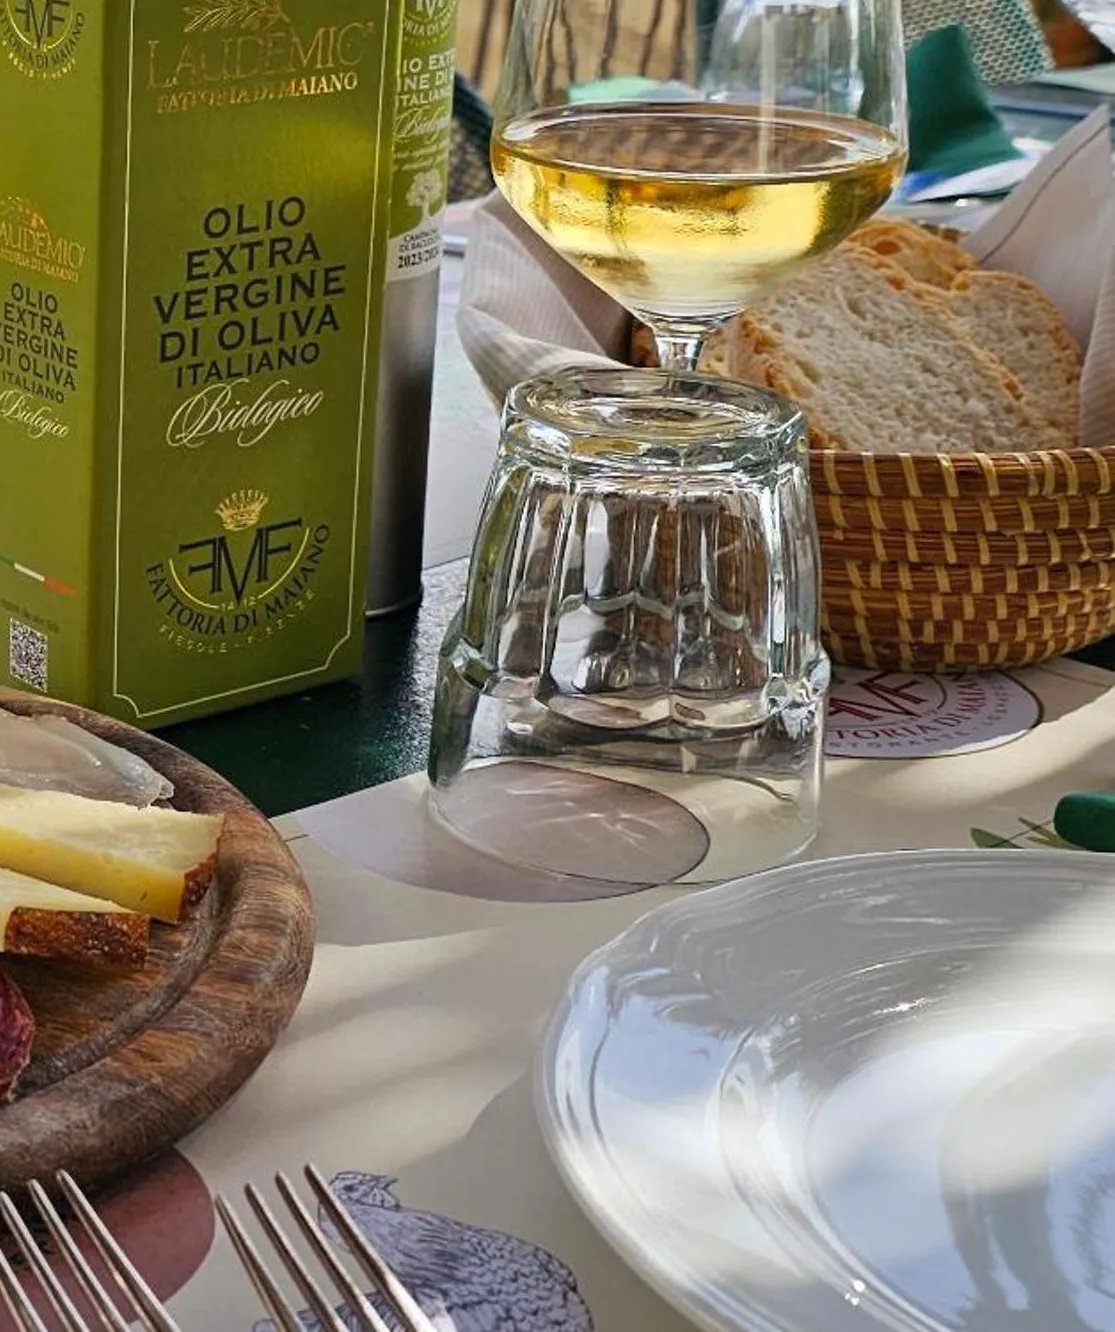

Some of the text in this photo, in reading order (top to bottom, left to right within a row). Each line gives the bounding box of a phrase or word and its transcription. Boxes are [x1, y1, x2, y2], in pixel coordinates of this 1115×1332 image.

[277, 71, 359, 99] MAIANO
[203, 196, 305, 239] OLIO
[186, 232, 321, 282] EXTRA
[11, 282, 58, 314] OLIO
[154, 264, 347, 325] VERGINE
[4, 302, 65, 340] EXTRA
[159, 303, 340, 363] DI OLIVA
[1, 370, 65, 404] ITALIANO
[18, 353, 77, 391] OLIVA
[176, 342, 320, 389] ITALIANO
[166, 378, 324, 448] Biologico
[147, 562, 226, 636] FATTORIA
[234, 608, 258, 634] DI
[264, 524, 330, 619] MAIANO
[828, 723, 940, 740] TORIA
